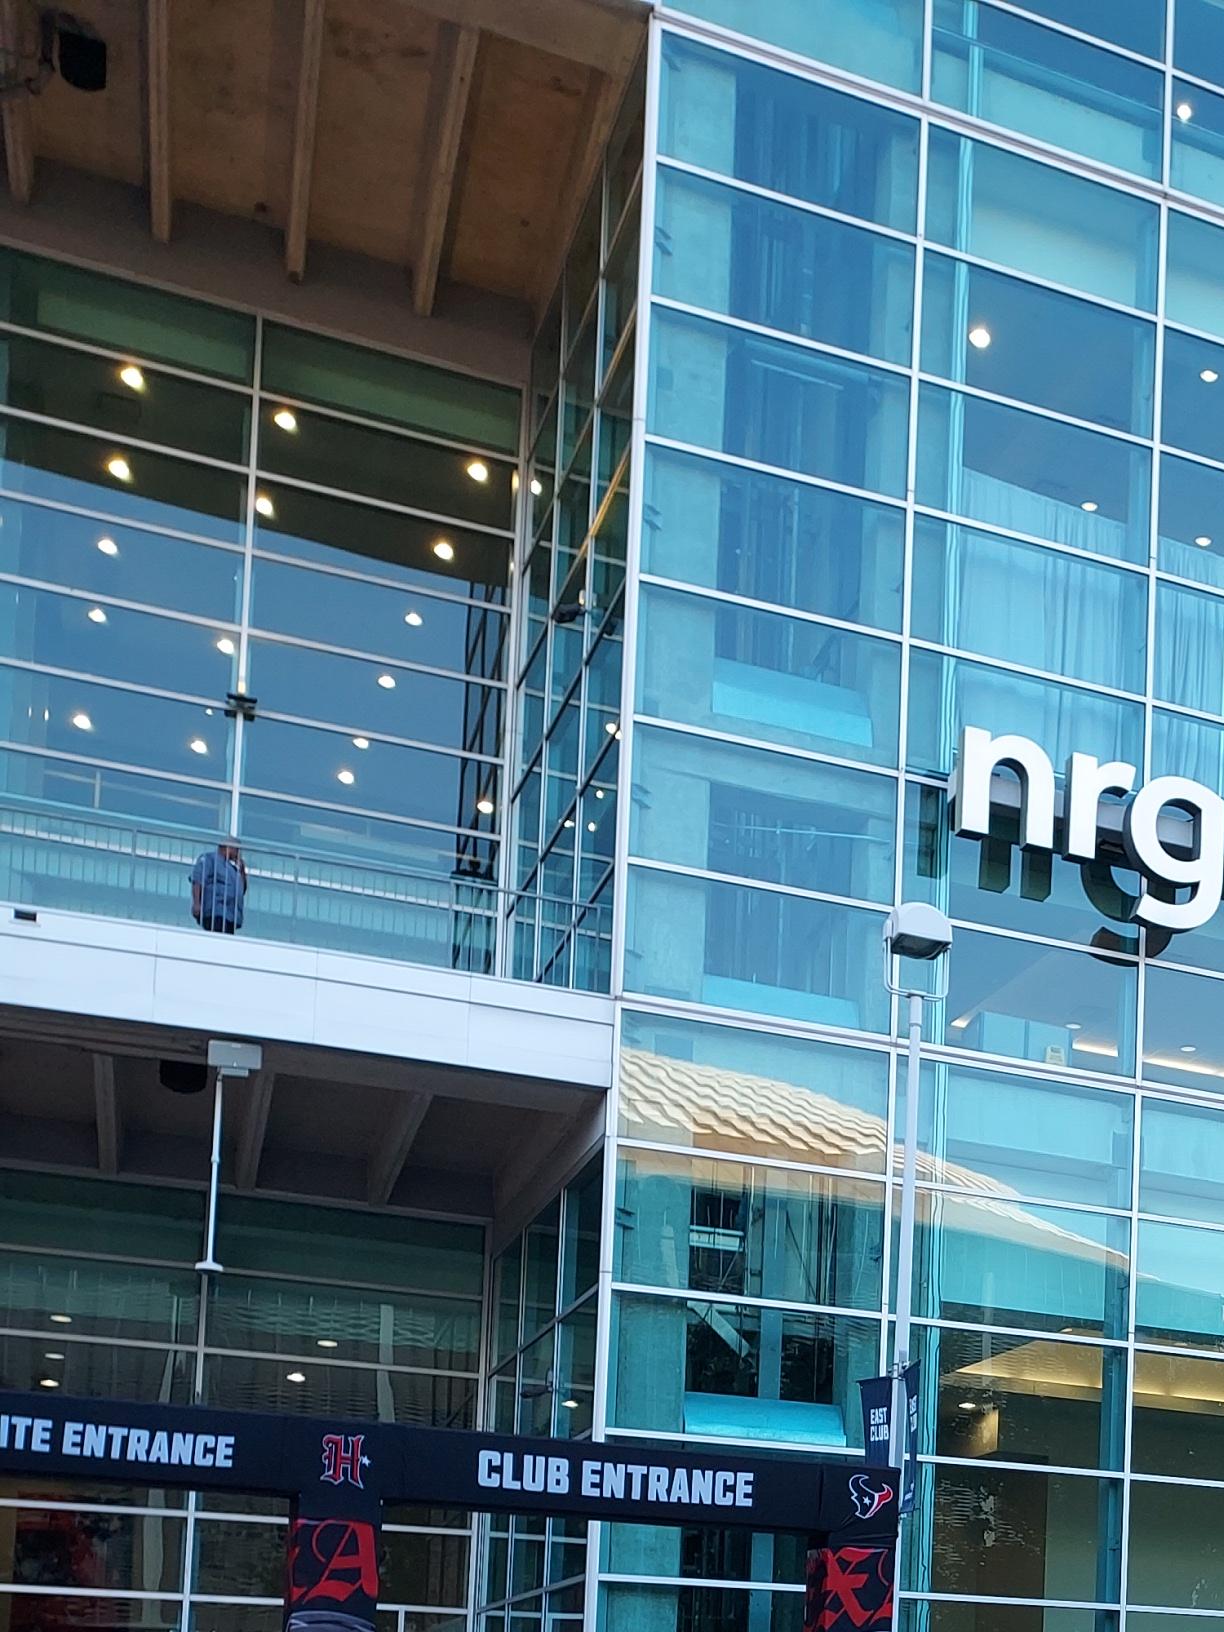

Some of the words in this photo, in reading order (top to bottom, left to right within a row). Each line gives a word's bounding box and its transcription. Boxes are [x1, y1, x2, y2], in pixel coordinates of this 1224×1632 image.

[869, 1407, 888, 1425] EAST
[61, 1421, 236, 1468] ENTRANCE
[869, 1424, 889, 1441] CLUB
[477, 1449, 570, 1494] CLUB
[581, 1459, 755, 1507] ENTRANCE
